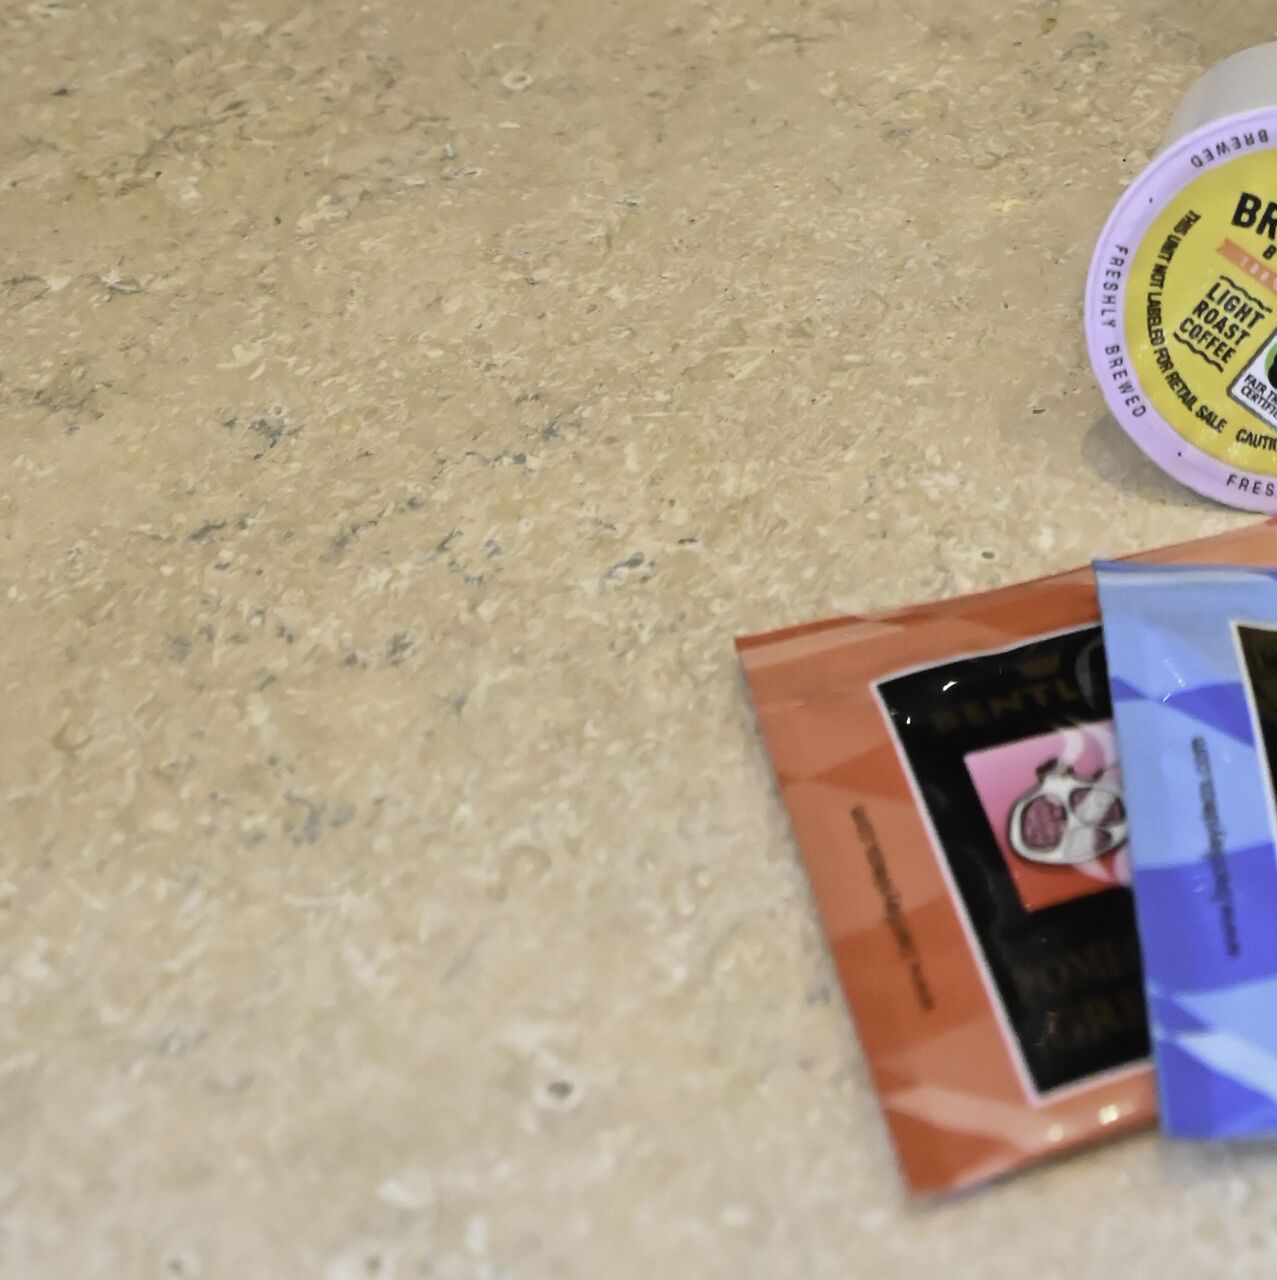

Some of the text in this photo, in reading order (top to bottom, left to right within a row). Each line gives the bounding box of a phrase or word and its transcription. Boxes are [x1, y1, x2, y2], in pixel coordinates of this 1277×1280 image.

[1191, 129, 1269, 167] BREWED
[1146, 210, 1228, 433] THIS UNIT NOT LABELED FOR RETAIL SALE
[1193, 300, 1250, 346] ROAST
[1206, 282, 1265, 328] LIGHT
[1101, 244, 1147, 418] FRESHLY BREWED
[1179, 317, 1236, 364] COFFEE
[1244, 374, 1269, 395] FAIR
